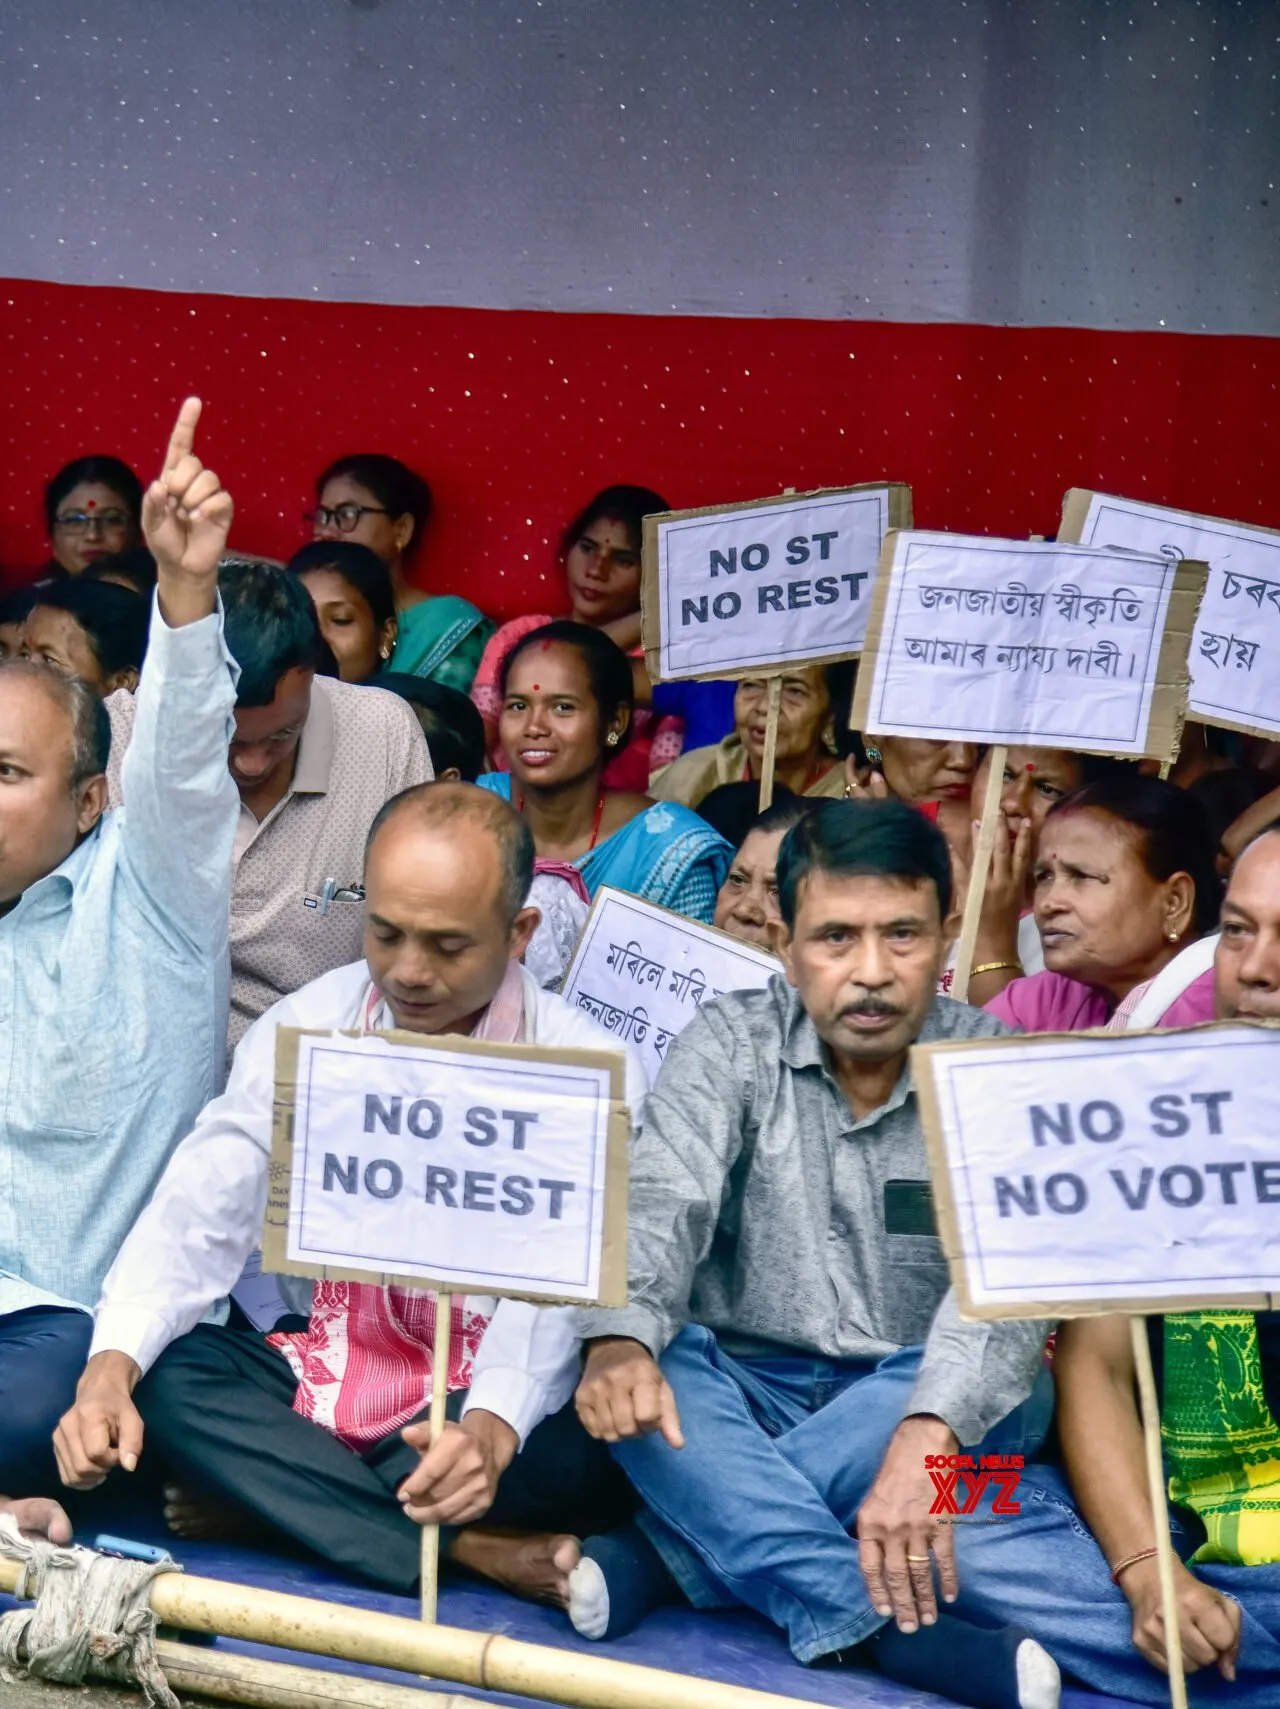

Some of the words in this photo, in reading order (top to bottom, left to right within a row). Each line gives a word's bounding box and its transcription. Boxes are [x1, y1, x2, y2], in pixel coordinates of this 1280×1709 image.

[709, 543, 770, 578] NO
[785, 531, 839, 566] ST
[681, 591, 742, 626] NO
[757, 572, 868, 614] REST
[918, 581, 1047, 618] জনজাতীয়
[1051, 583, 1144, 629] স্বীকৃতি
[904, 637, 988, 668] আমাৰ
[1199, 630, 1261, 672] হায়
[606, 940, 666, 991] মৰিলে
[363, 1093, 443, 1140] NO
[463, 1106, 539, 1151] ST
[1029, 1100, 1124, 1147] NO
[1149, 1090, 1232, 1138] ST
[322, 1152, 403, 1200] NO
[425, 1164, 576, 1220] REST
[993, 1172, 1088, 1218] NO
[1109, 1160, 1280, 1211] VOTE
